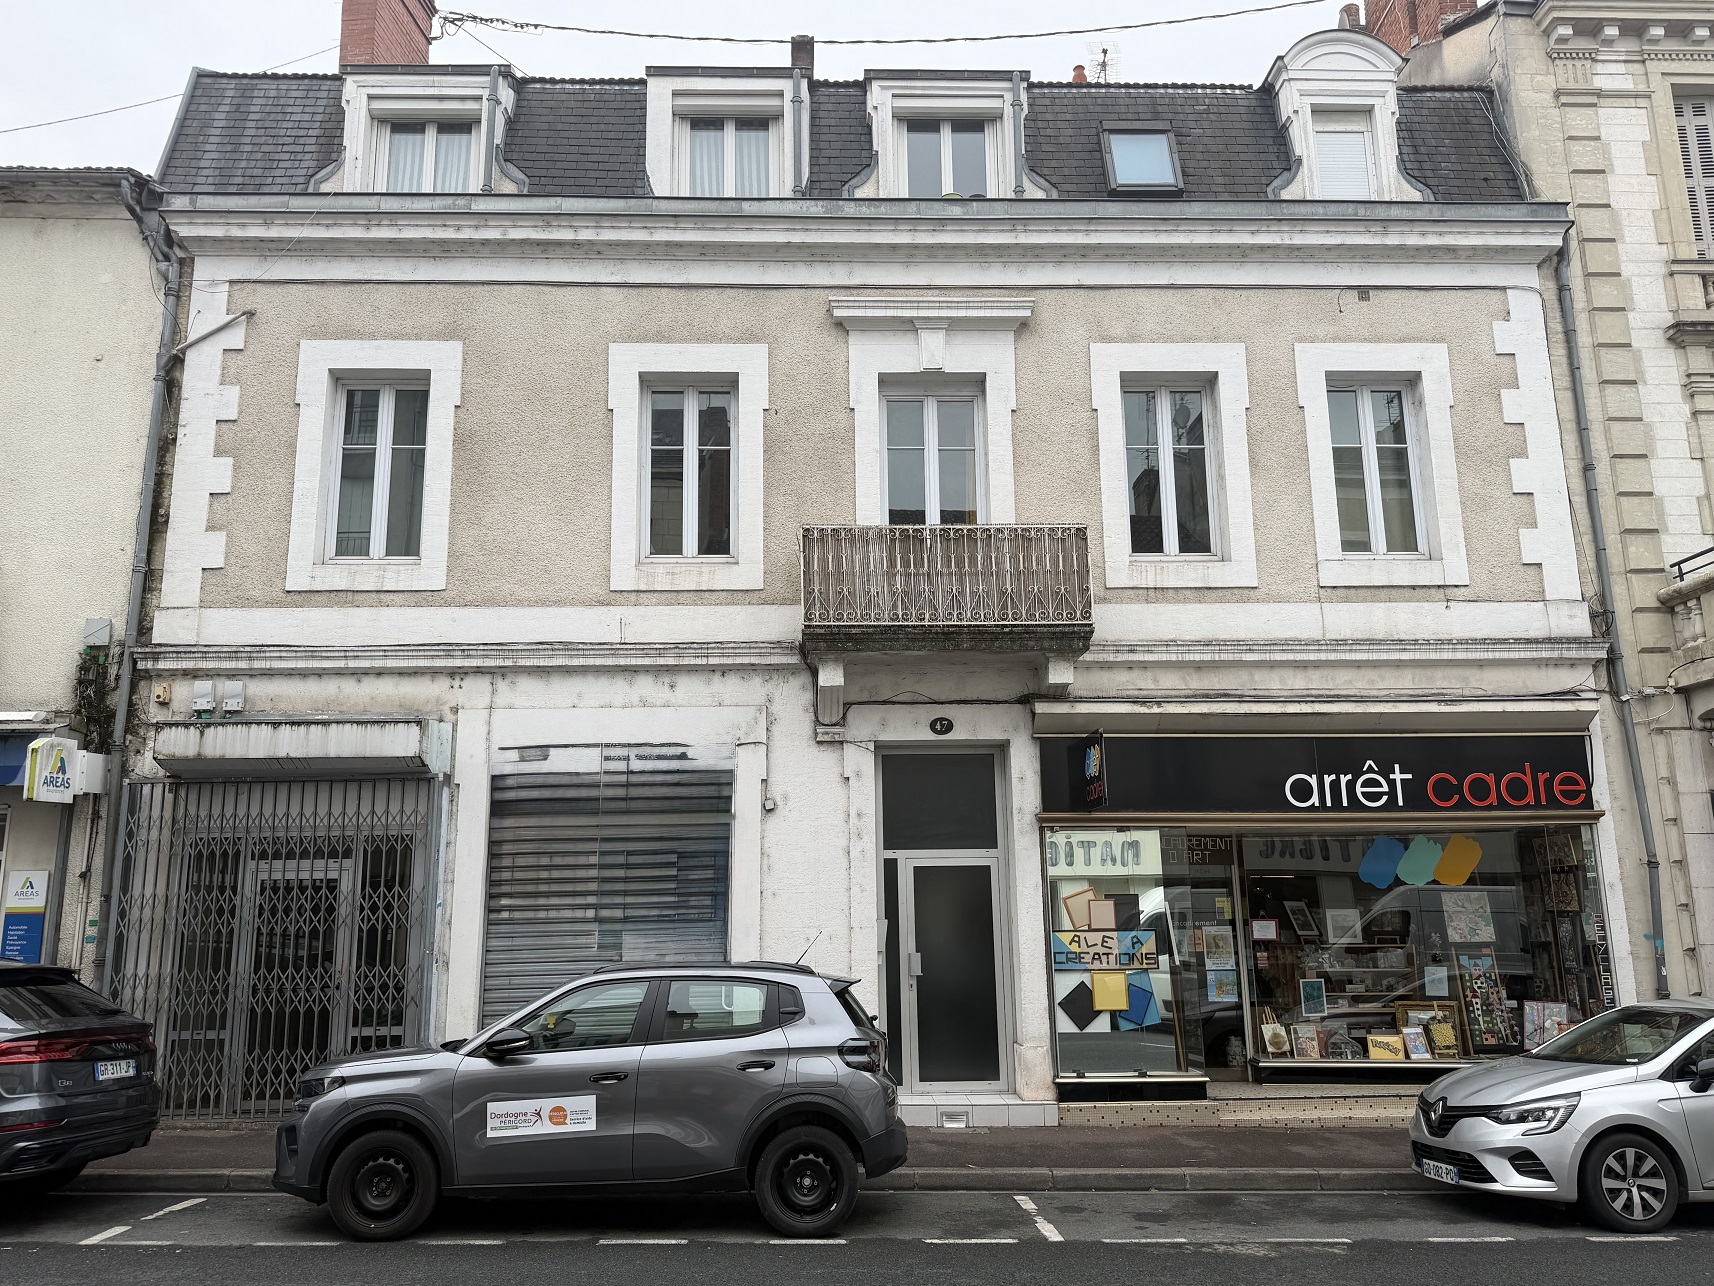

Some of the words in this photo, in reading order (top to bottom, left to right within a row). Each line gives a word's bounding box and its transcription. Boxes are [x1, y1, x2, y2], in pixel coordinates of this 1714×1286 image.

[935, 721, 948, 730] 47
[42, 775, 71, 789] AREAS
[1284, 759, 1412, 808] arrêt
[1427, 763, 1586, 808] cadre
[1168, 850, 1211, 863] D'ART
[1068, 933, 1144, 950] ALEXA
[1053, 951, 1157, 966] CREATIONS
[1594, 913, 1614, 1007] RECYCLAGE
[490, 1111, 528, 1119] Dordogne
